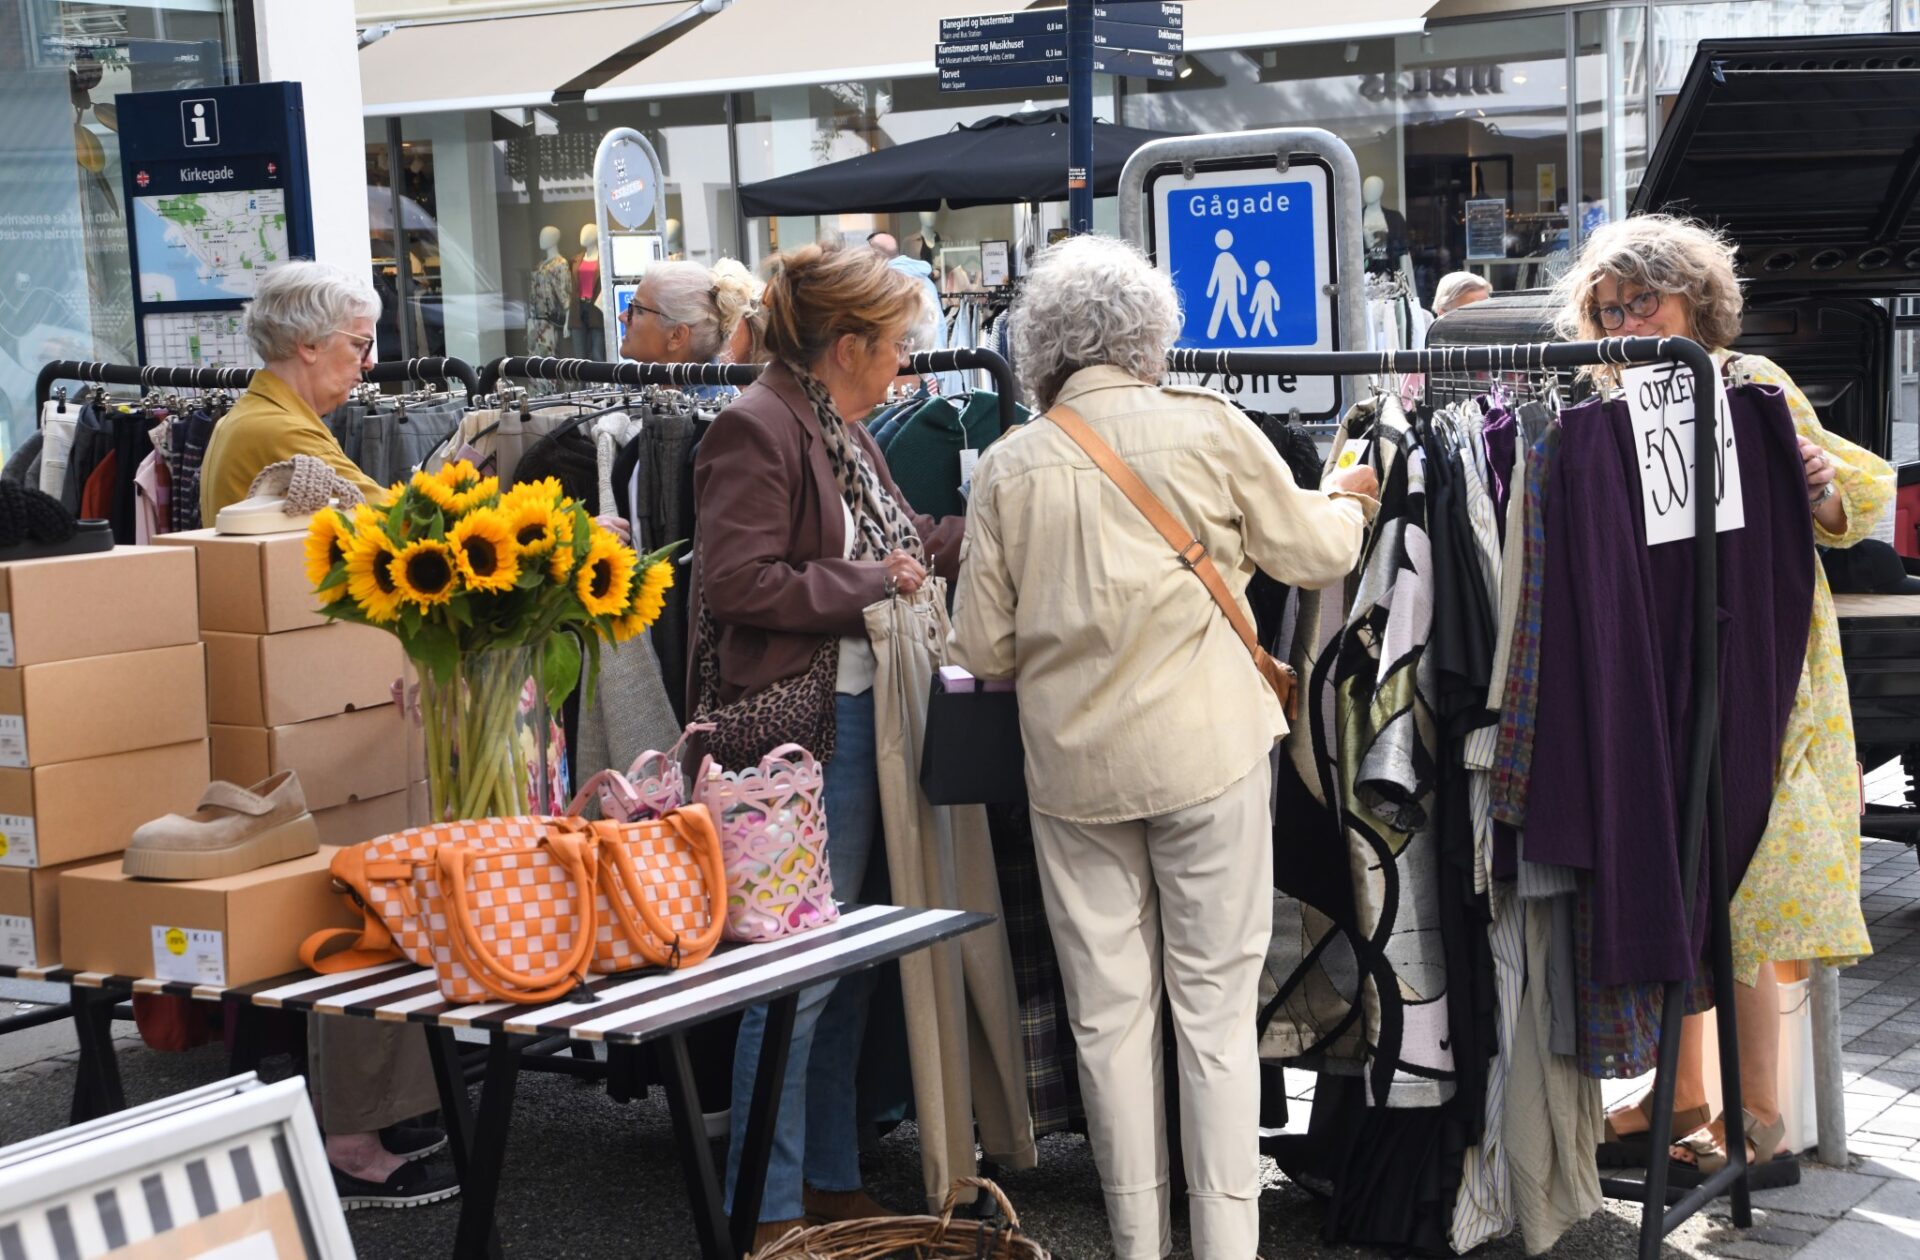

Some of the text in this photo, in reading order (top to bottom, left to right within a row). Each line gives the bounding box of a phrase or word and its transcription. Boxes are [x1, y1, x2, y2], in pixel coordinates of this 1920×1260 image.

[942, 13, 1014, 30] Banegård og busterminal
[1046, 22, 1063, 31] 0,8 km
[967, 30, 982, 38] Station
[938, 40, 1024, 54] Kunstmuseum og Musikhuset
[945, 56, 962, 64] Museum
[971, 53, 992, 63] Performing
[992, 53, 1001, 61] Arts
[1001, 52, 1015, 60] Centre
[1045, 49, 1062, 58] 0,3 km
[942, 69, 960, 79] Torvet
[1046, 74, 1063, 83] 0,2 km
[952, 81, 966, 90] Square
[180, 166, 234, 183] Kirkegade
[1188, 192, 1290, 219] Gågade
